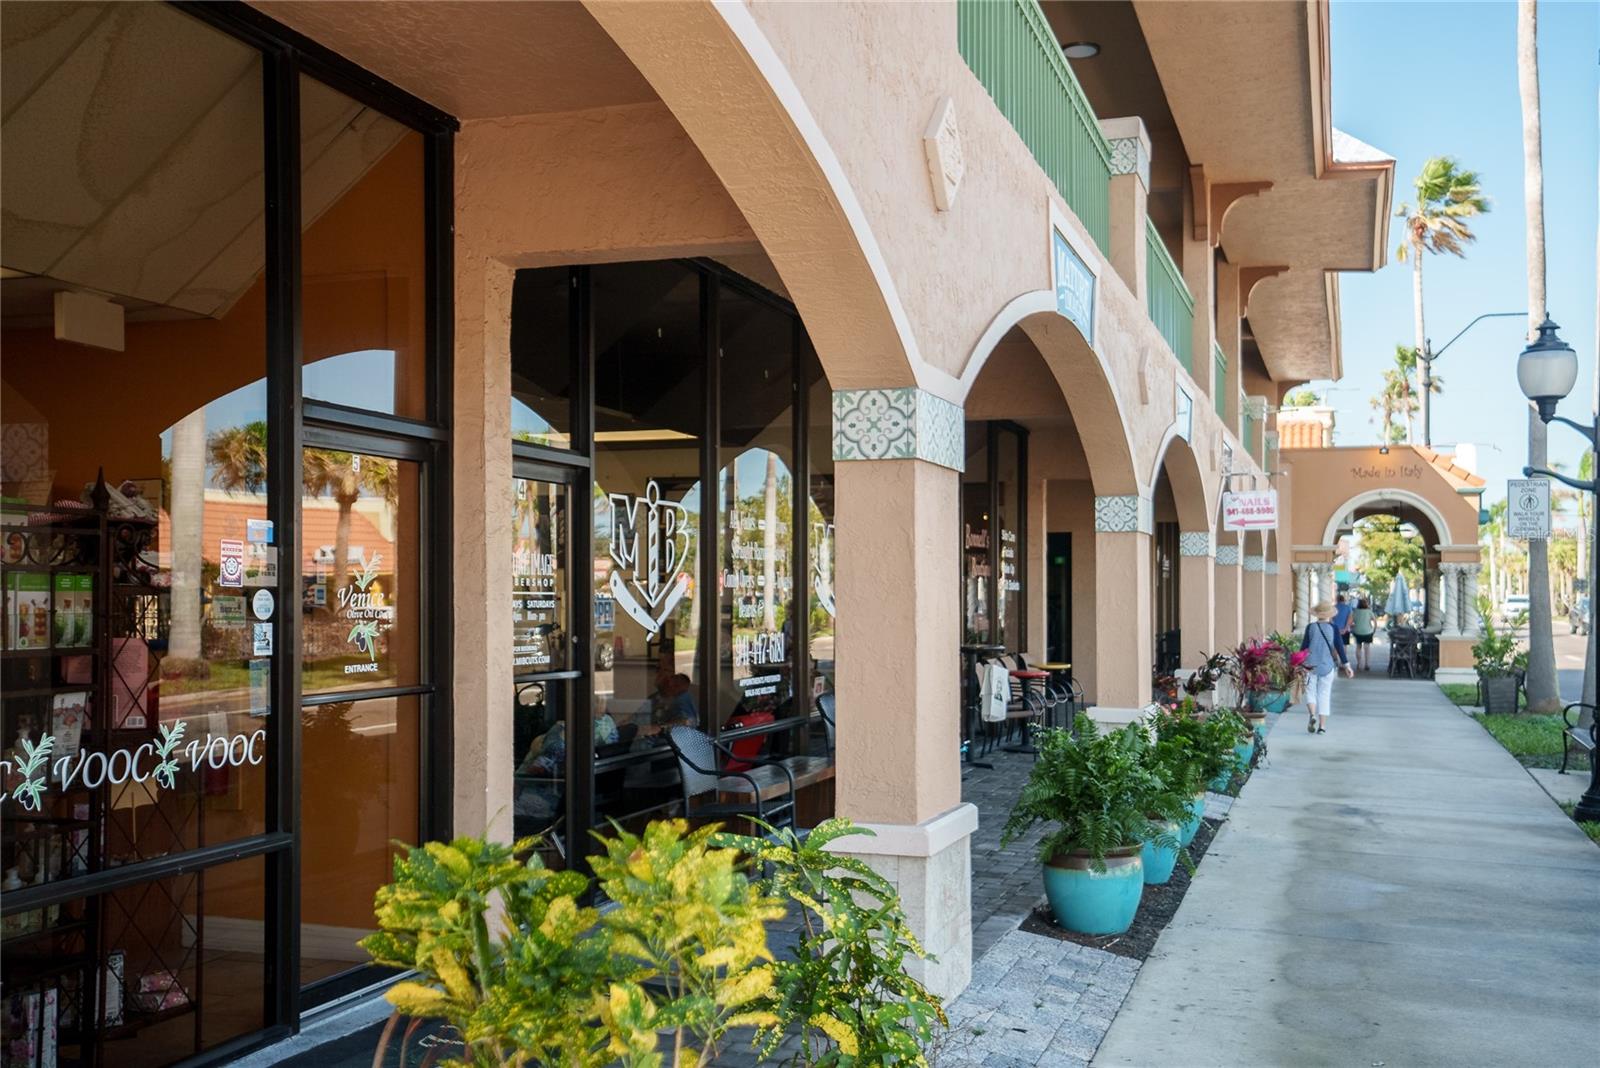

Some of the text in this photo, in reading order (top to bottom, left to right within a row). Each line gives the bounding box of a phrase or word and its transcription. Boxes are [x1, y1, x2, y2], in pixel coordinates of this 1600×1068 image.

[353, 456, 360, 471] 5
[1350, 466, 1381, 478] Made
[1400, 465, 1423, 479] Italy
[518, 481, 526, 497] 4
[1240, 497, 1270, 506] NAILS
[514, 577, 554, 588] BERSHOP
[337, 584, 385, 608] Venice
[344, 662, 378, 674] ENTRANCE
[53, 743, 153, 793] VOOC
[185, 729, 267, 773] VOOC
